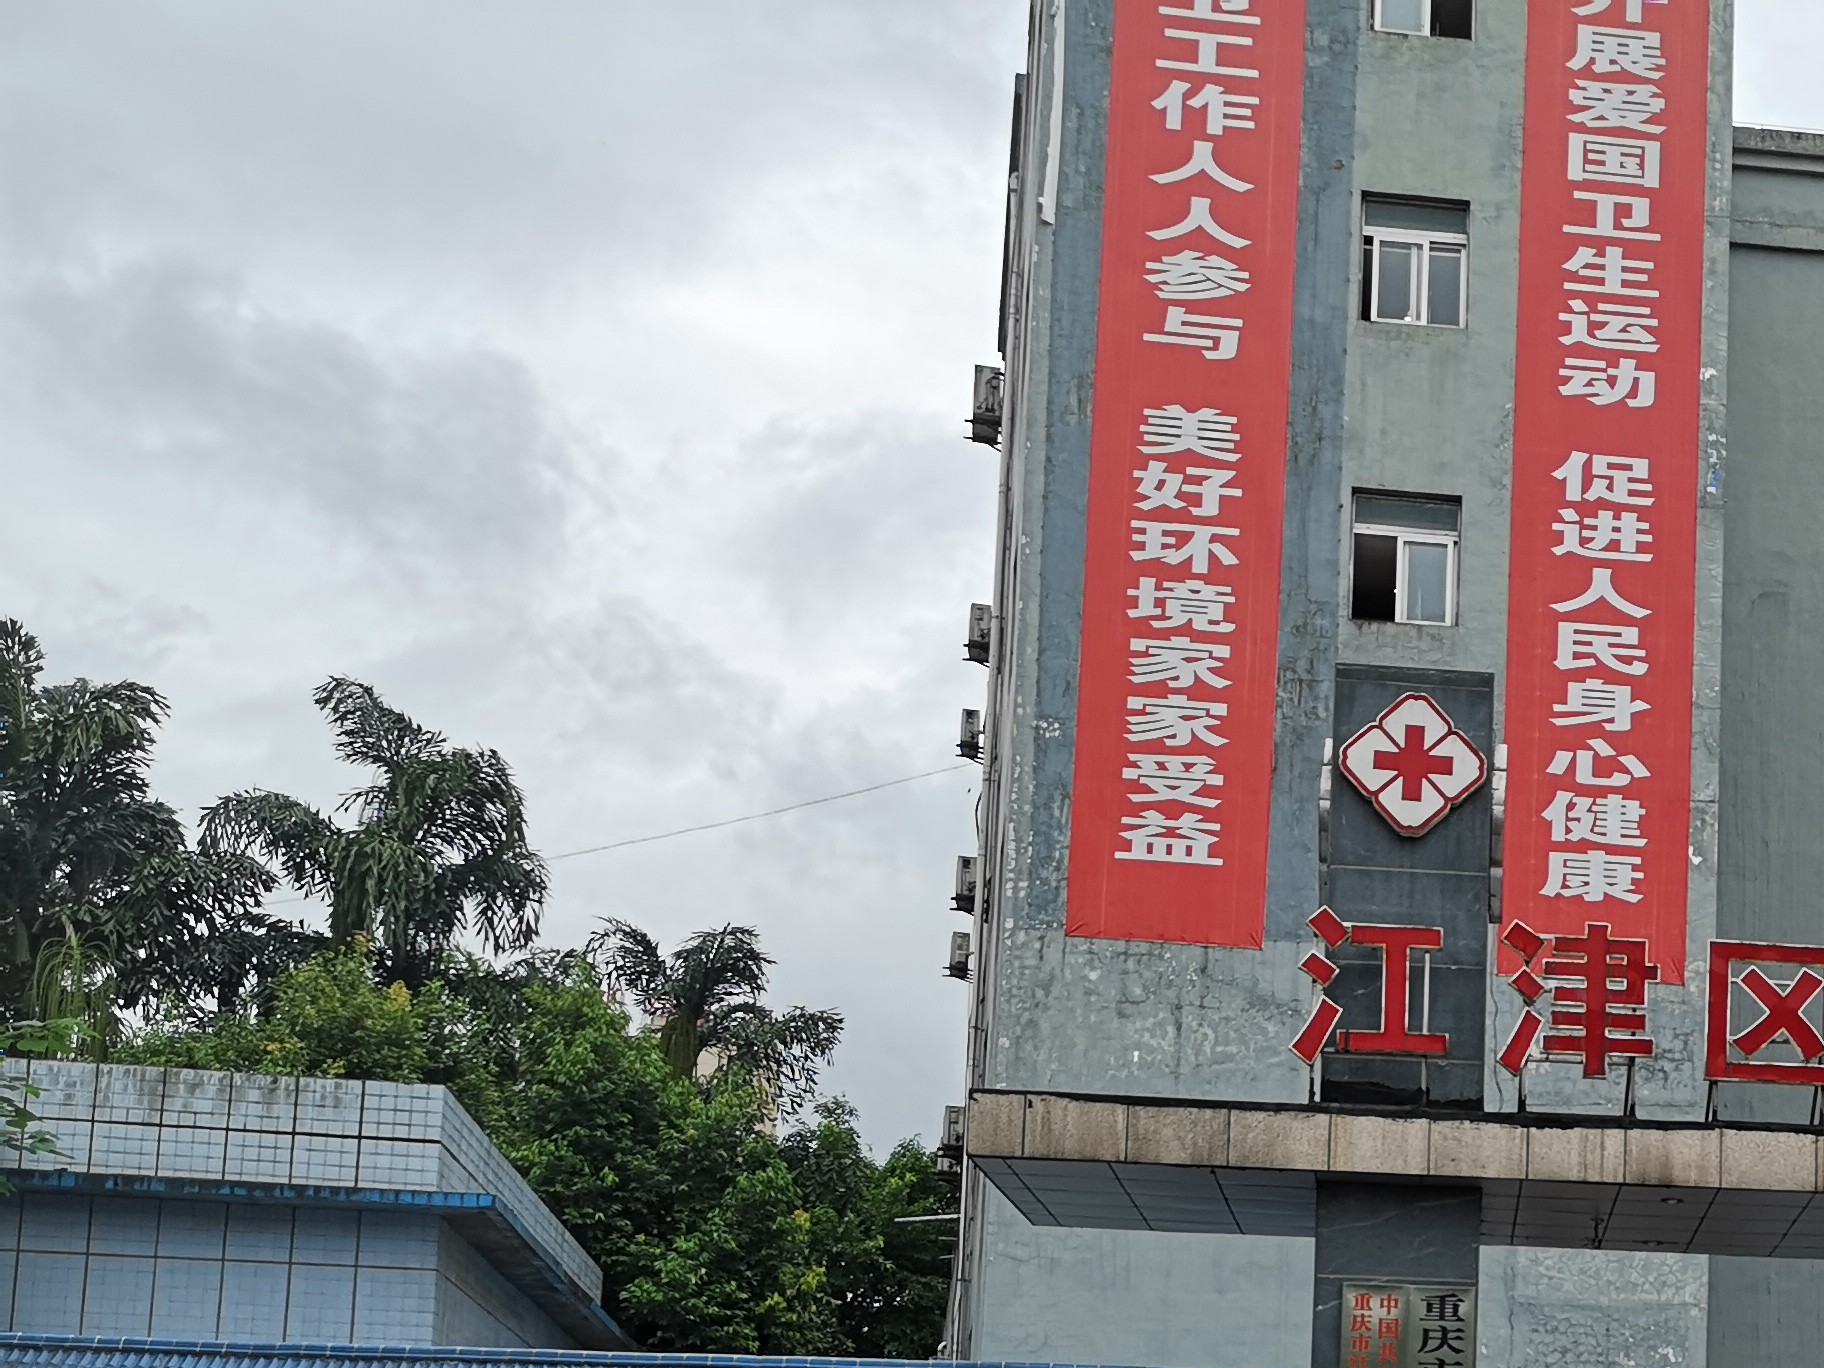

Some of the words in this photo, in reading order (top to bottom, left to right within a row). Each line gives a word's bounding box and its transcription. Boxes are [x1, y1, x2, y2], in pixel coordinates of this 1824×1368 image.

[1114, 403, 1243, 867] 美好环境家家受益
[1540, 450, 1656, 903] 促进人民身心健康
